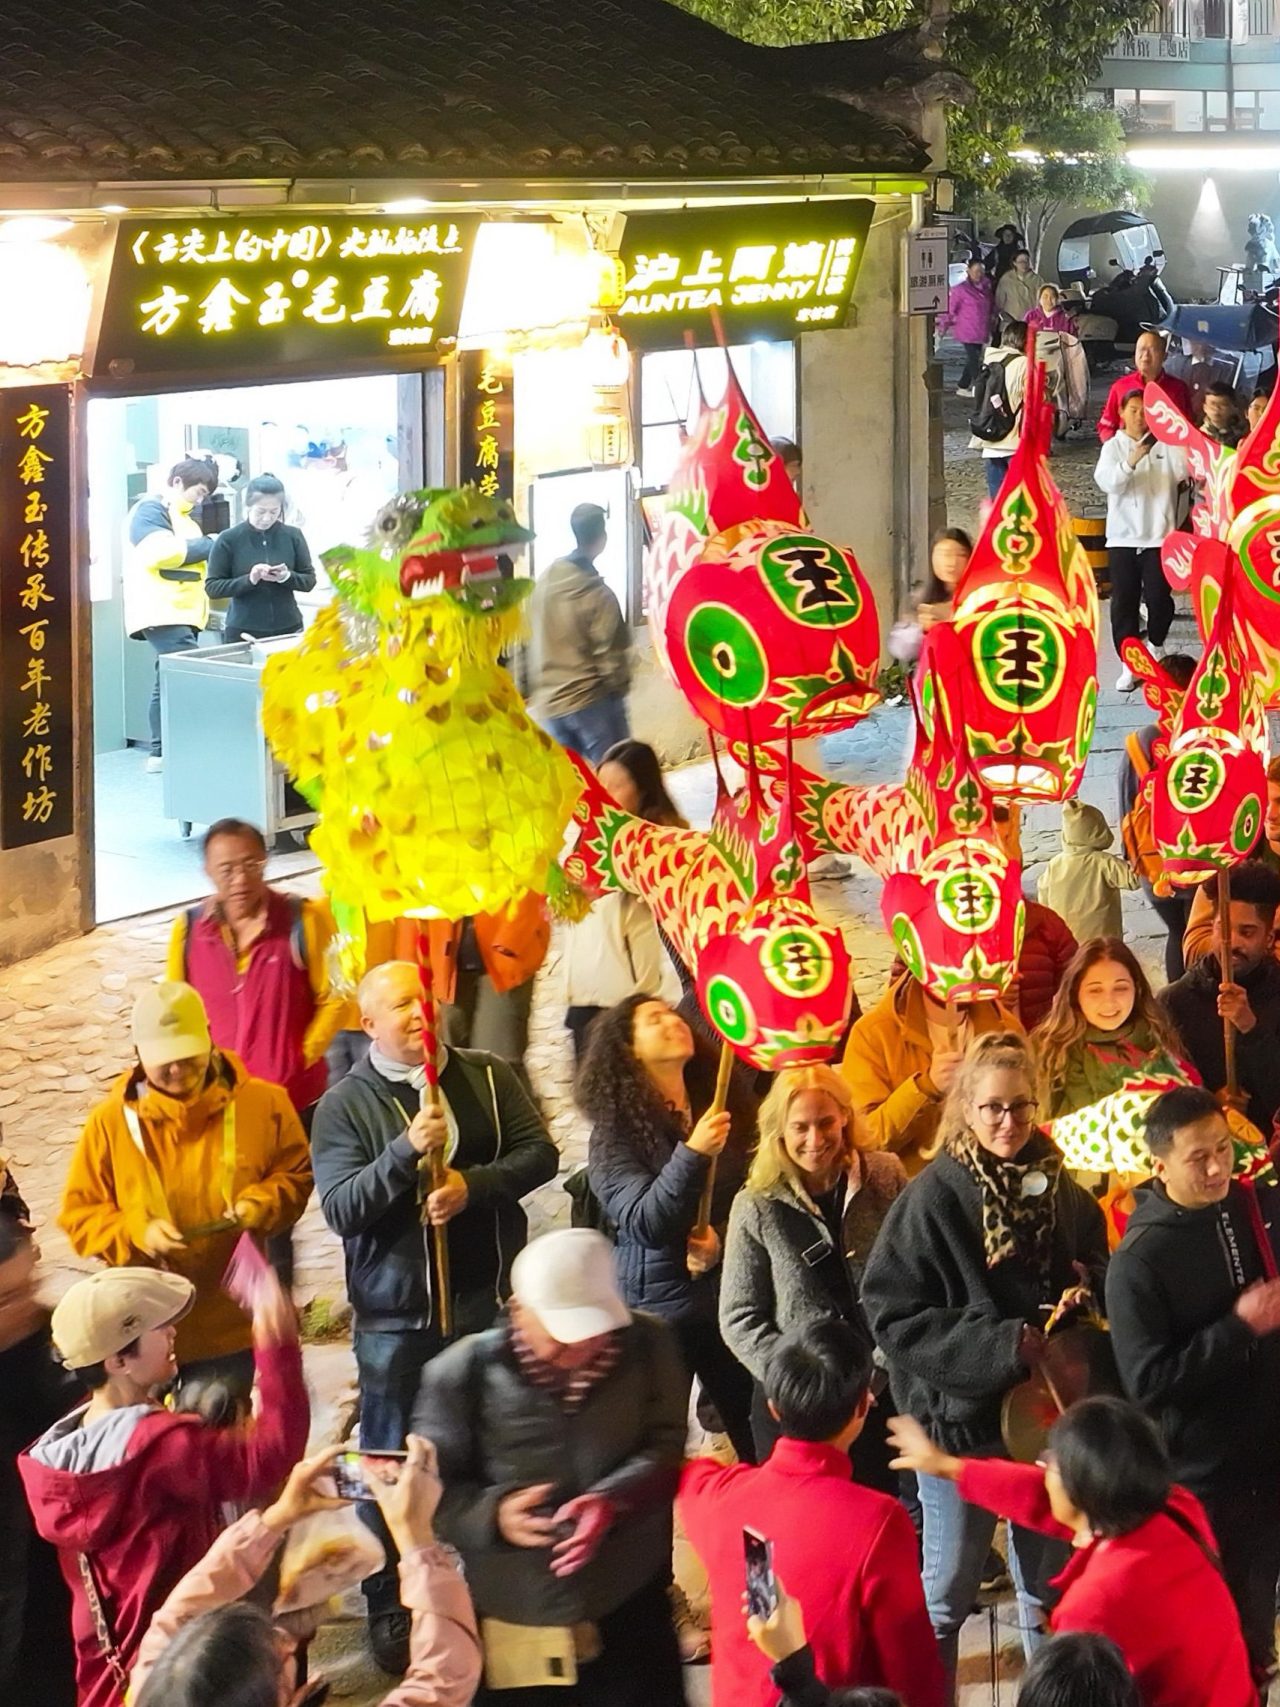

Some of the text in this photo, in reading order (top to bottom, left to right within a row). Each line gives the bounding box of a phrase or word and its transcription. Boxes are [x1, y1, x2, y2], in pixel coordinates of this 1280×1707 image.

[618, 279, 815, 316] AUNTEA JENNY
[16, 404, 57, 823] 方鑫玉传承百年老作坊
[1221, 1211, 1246, 1285] ELEMENTS
